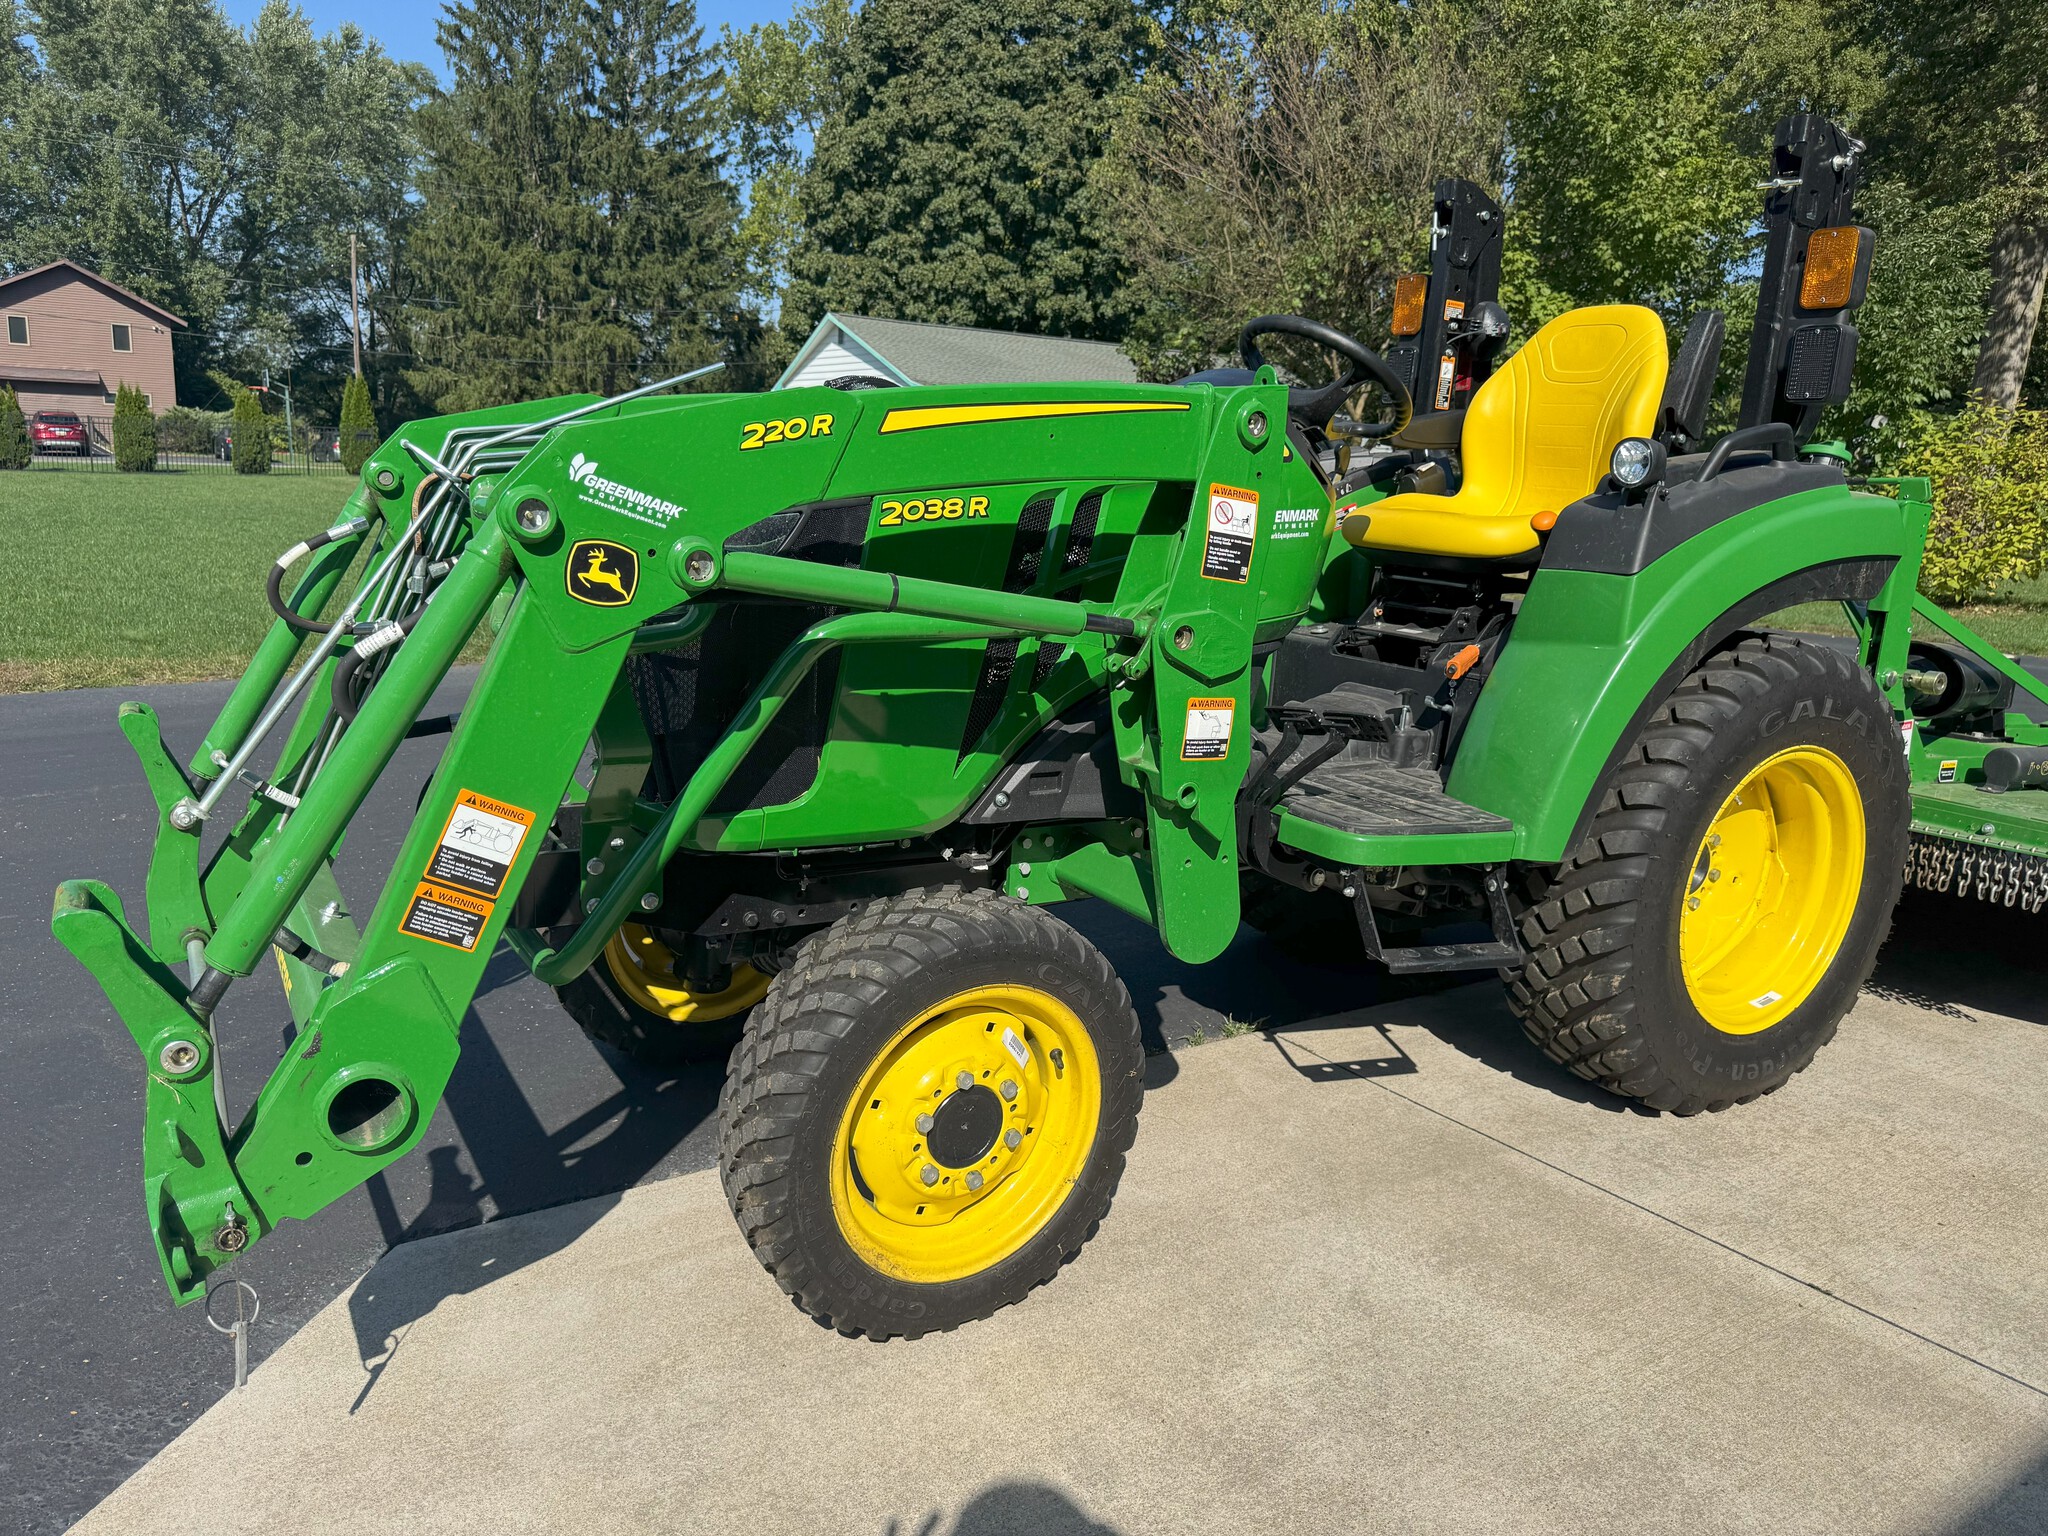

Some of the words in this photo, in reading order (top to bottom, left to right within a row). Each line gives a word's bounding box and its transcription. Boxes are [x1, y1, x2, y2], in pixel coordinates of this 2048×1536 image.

[739, 418, 807, 451] 220
[810, 414, 835, 437] R
[583, 474, 684, 519] GREENMARK
[588, 488, 672, 523] EQUIPMENT
[1220, 487, 1257, 502] WARNING
[879, 498, 964, 527] 2038
[968, 496, 991, 519] R
[1274, 508, 1320, 523] ENMARK
[479, 799, 525, 821] WARNING
[438, 892, 485, 912] WARNING
